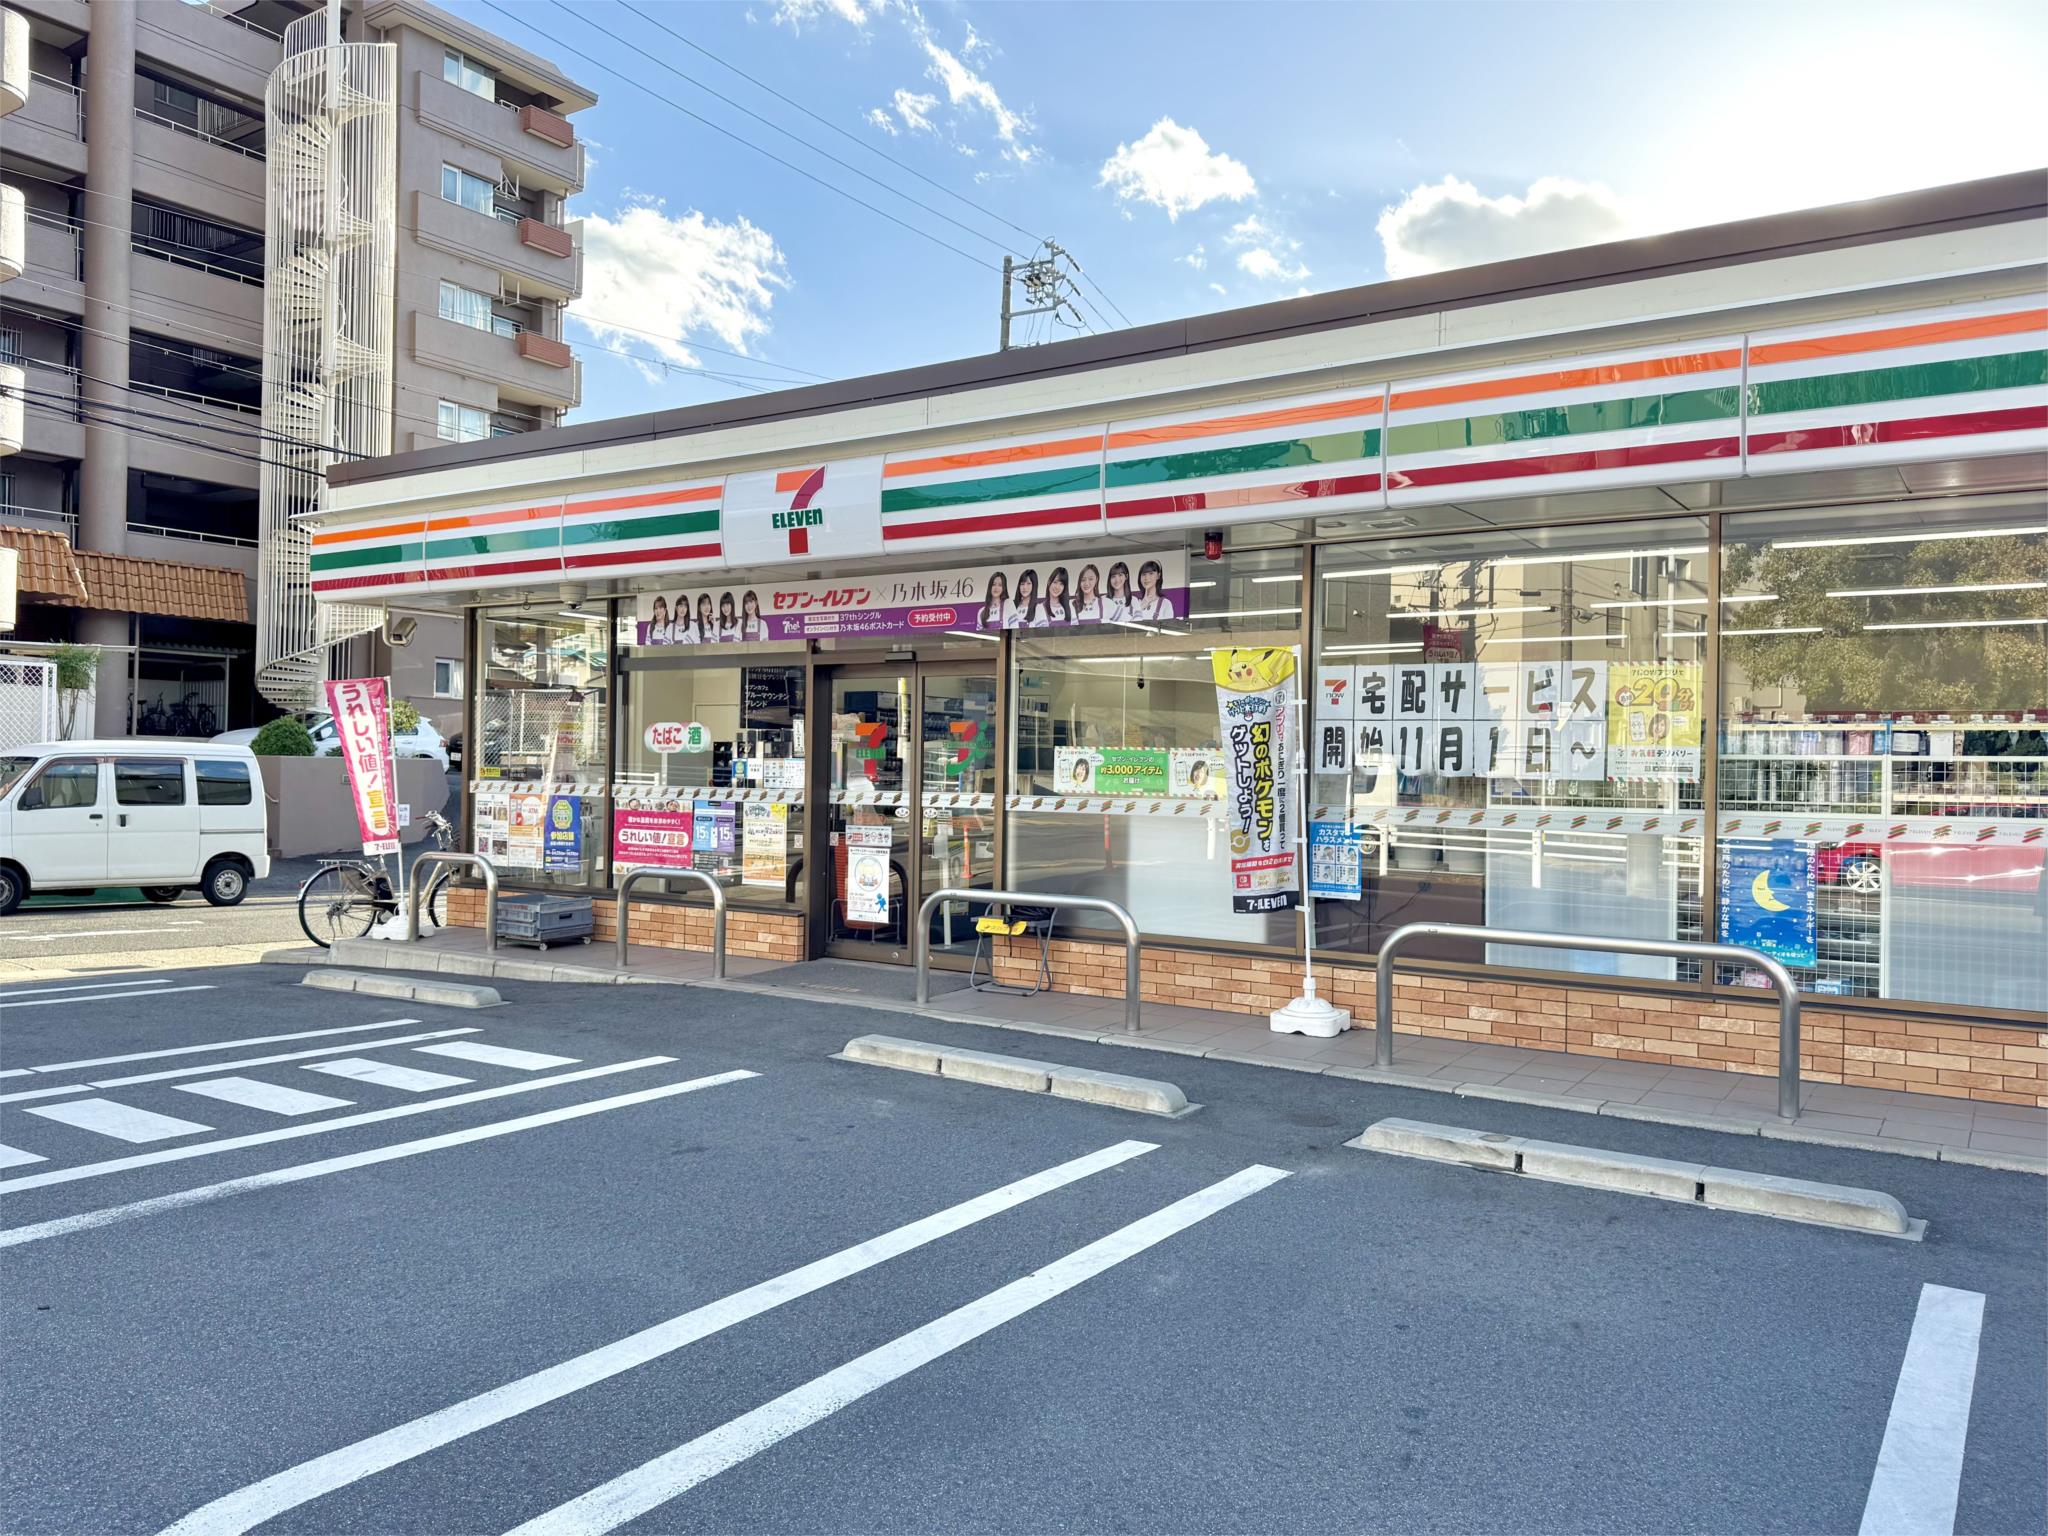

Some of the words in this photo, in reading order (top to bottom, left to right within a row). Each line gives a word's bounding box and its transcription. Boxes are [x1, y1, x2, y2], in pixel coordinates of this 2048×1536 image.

[775, 465, 825, 554] 7
[891, 577, 974, 602] 乃木坂46
[840, 620, 904, 632] 乃木坂46ポストカード
[913, 613, 951, 623] 予約受付中
[653, 727, 682, 745] たばこ
[688, 727, 702, 745] 酒
[1101, 765, 1162, 776] 約3,000アイテム
